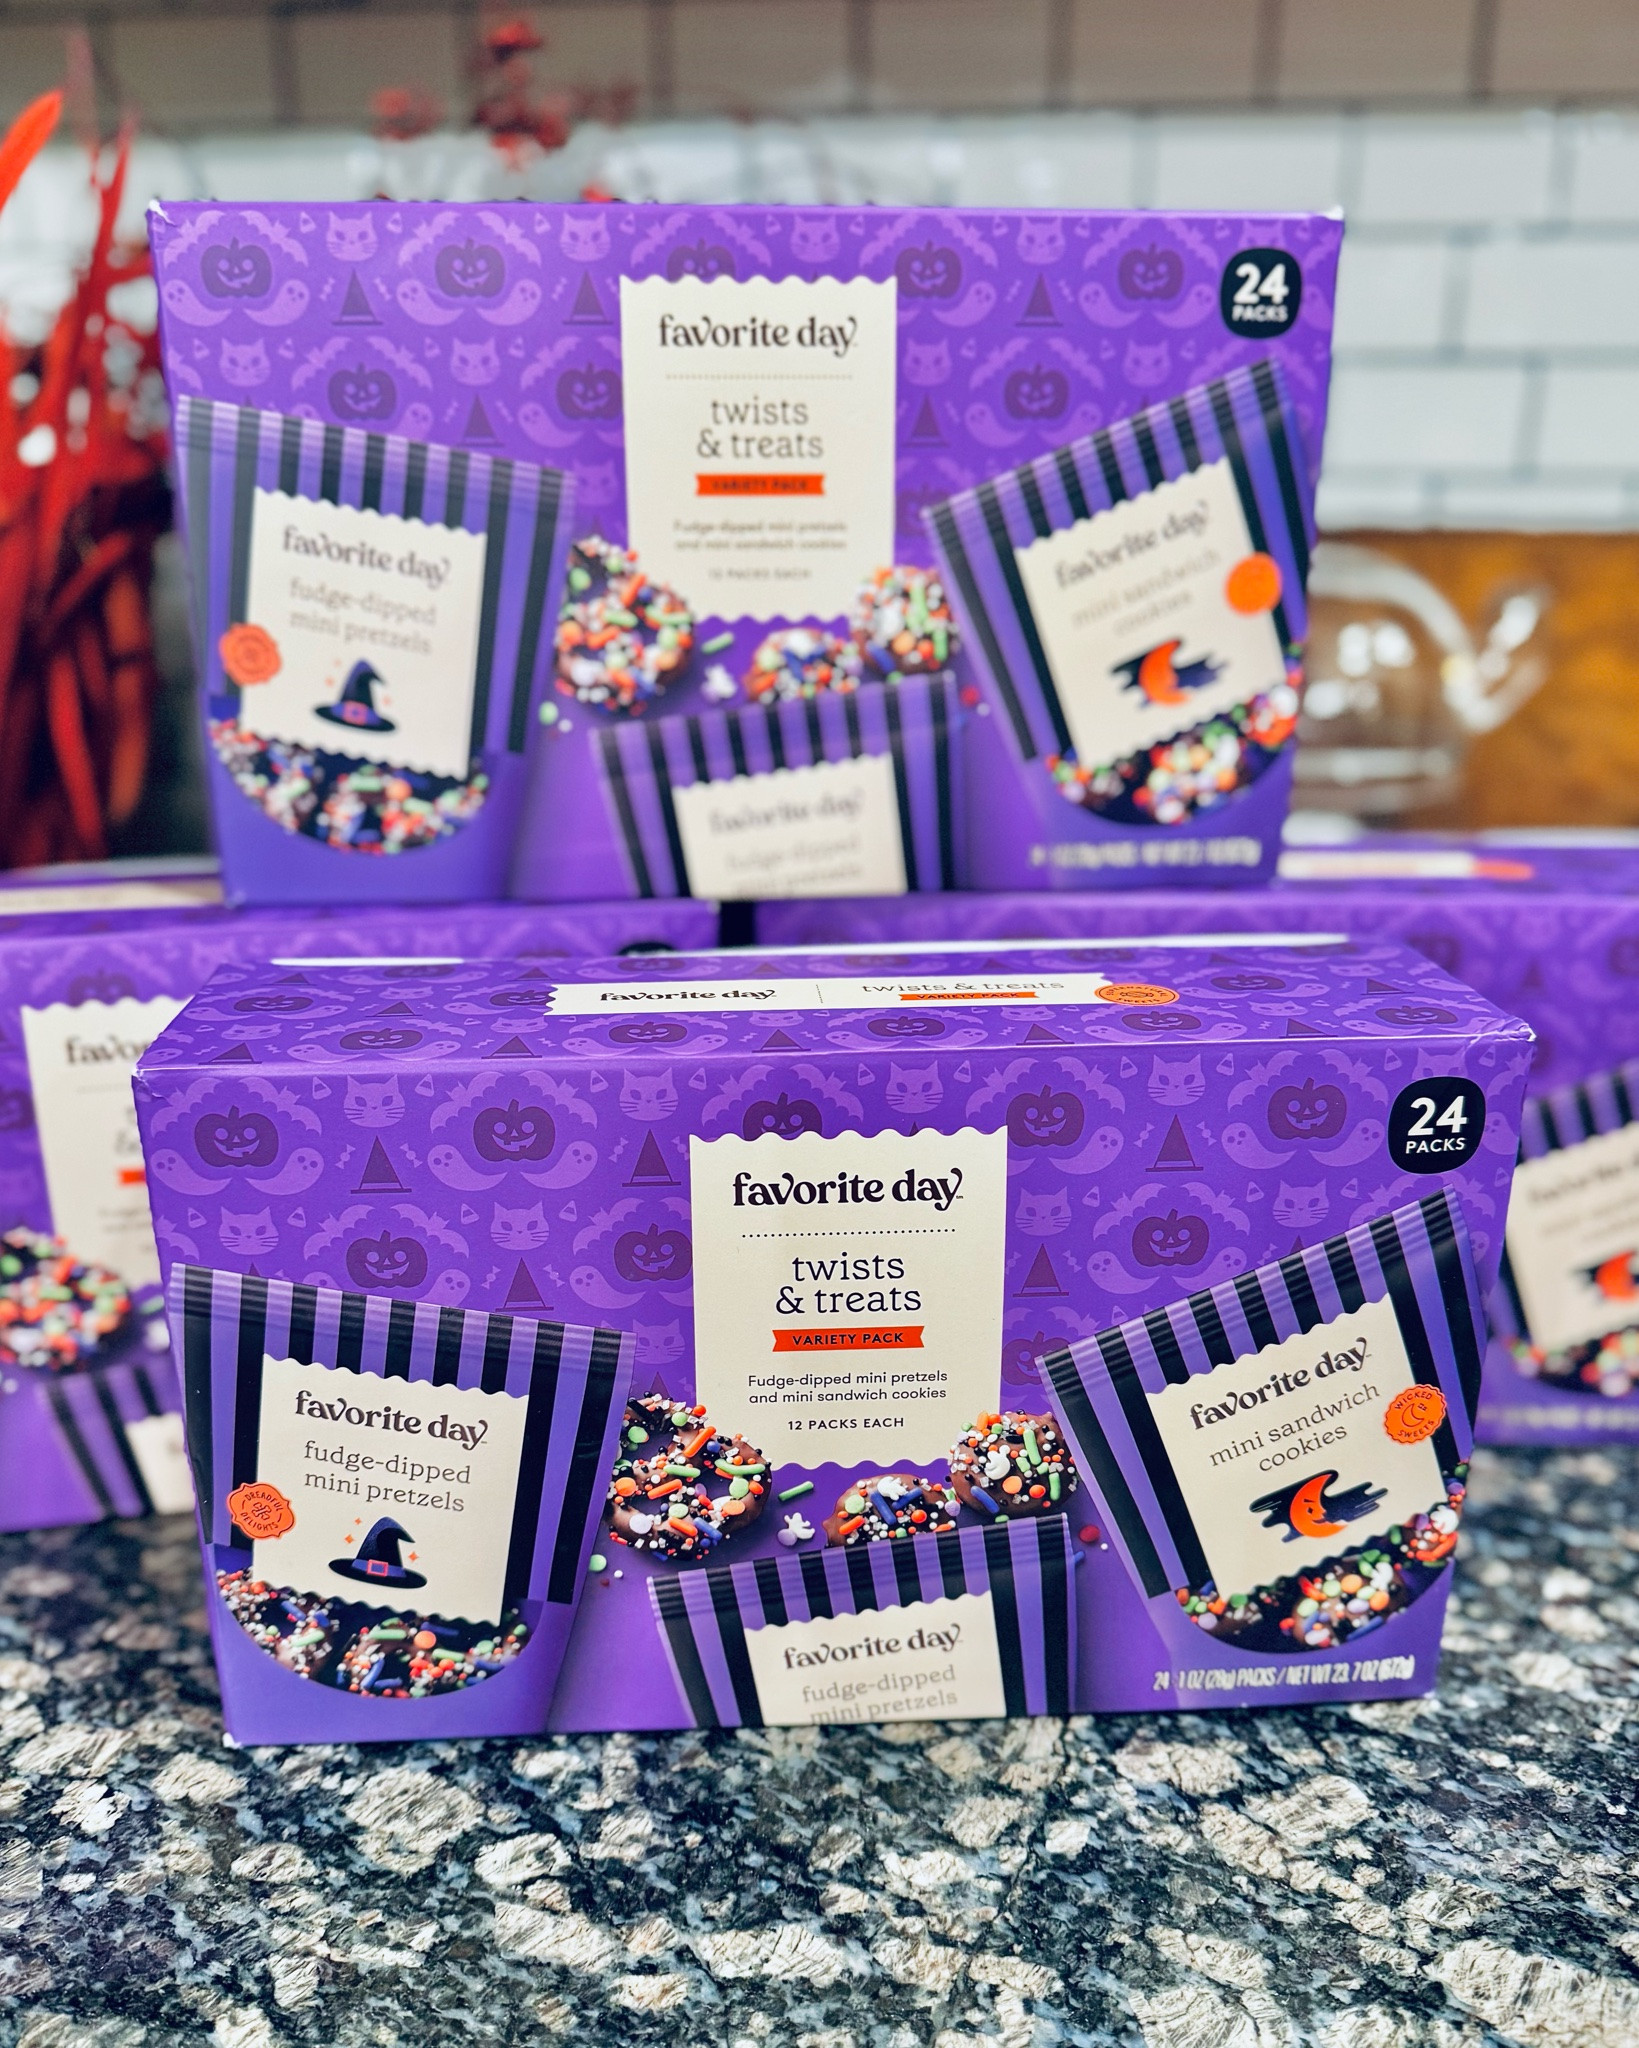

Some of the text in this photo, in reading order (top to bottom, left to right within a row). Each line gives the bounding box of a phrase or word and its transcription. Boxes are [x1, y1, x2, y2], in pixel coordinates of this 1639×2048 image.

[1233, 262, 1289, 304] 24
[1232, 304, 1288, 322] PACKS
[659, 314, 857, 357] favorite day
[711, 396, 809, 425] twists
[696, 428, 824, 458] & treats
[283, 524, 451, 592] favorite day
[600, 989, 777, 1001] favorite day
[862, 981, 1066, 993] twists & treats
[1407, 1095, 1468, 1136] 24
[1405, 1137, 1467, 1154] PACKS
[733, 1168, 963, 1211] favorite day
[791, 1251, 905, 1282] twists
[775, 1286, 922, 1314] & treats
[792, 1332, 905, 1346] VARIETY PACK
[748, 1370, 948, 1389] Fudge-dipped mini pretzels
[1190, 1336, 1368, 1430] favorite day
[749, 1387, 947, 1404] and mini sandwich cookies
[1394, 1391, 1433, 1410] WICKED
[295, 1390, 489, 1451] favorite day
[787, 1417, 905, 1431] 12 PACKS EACH
[1209, 1383, 1381, 1467] mini sandwich
[1397, 1420, 1435, 1438] SWEETS
[304, 1440, 471, 1484] fudge-dipped
[1259, 1425, 1348, 1472] cookies
[244, 1490, 283, 1512] DREADFUL
[304, 1472, 465, 1512] mini pretzels
[240, 1511, 279, 1531] DELIGHTS
[783, 1622, 962, 1670] favorite day
[802, 1664, 957, 1704] fudge-dipped
[809, 1689, 959, 1726] mini pretzels
